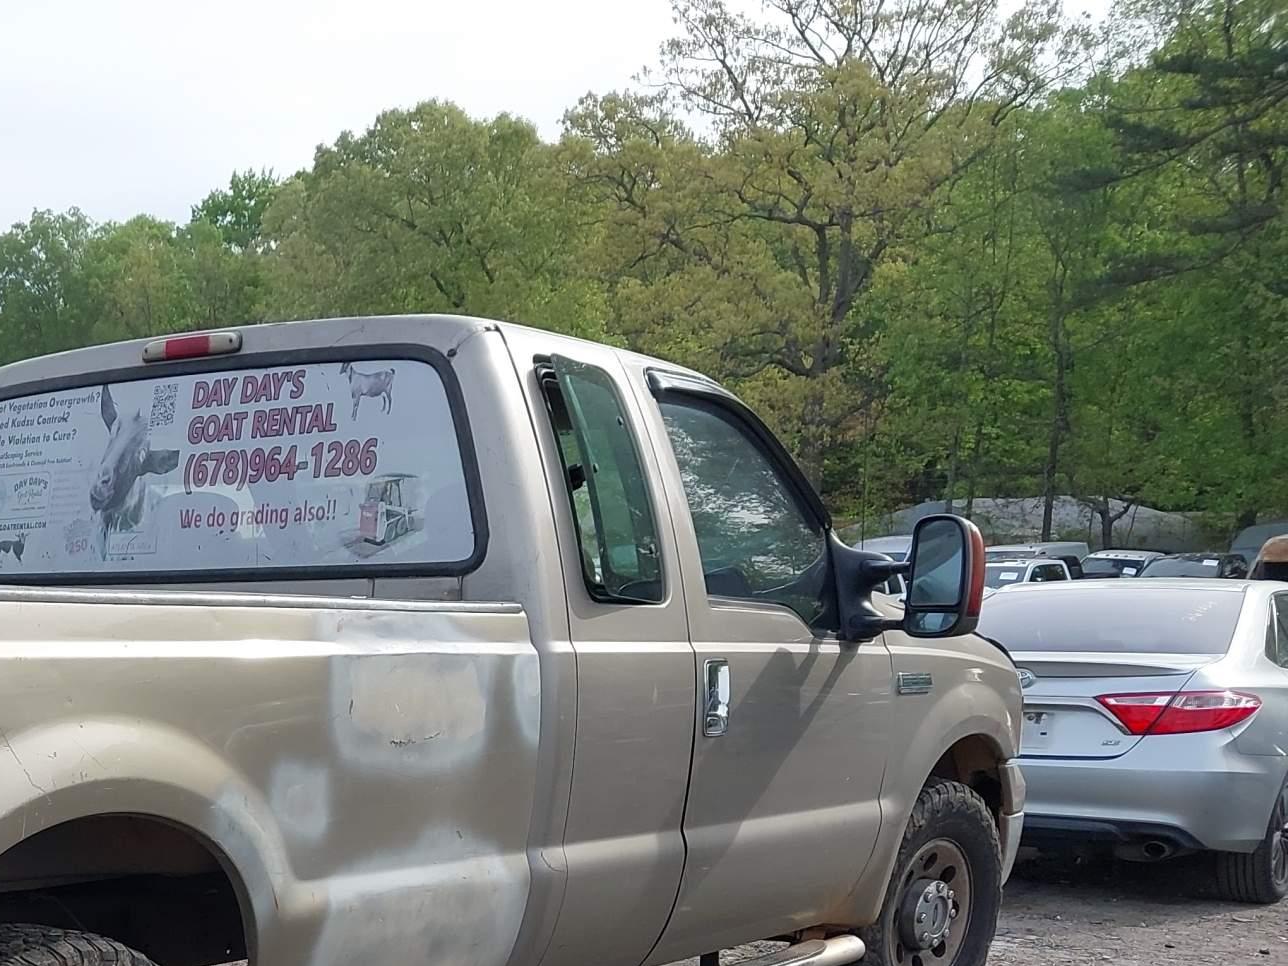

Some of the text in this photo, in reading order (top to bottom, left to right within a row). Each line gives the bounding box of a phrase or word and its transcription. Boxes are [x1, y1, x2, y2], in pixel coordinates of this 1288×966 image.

[192, 369, 307, 409] DAY DAY'S
[8, 399, 48, 415] Vegetation
[49, 392, 100, 409] Overgrowth?
[11, 416, 35, 429] Kudzu
[36, 412, 71, 425] Control?
[187, 403, 338, 445] GOAT RENTAL
[8, 433, 41, 446] Violation
[42, 433, 50, 443] to
[52, 428, 77, 441] Cure?
[183, 437, 378, 494] (678)964-1286
[14, 478, 28, 493] DAY
[179, 499, 337, 532] We do grading also!!
